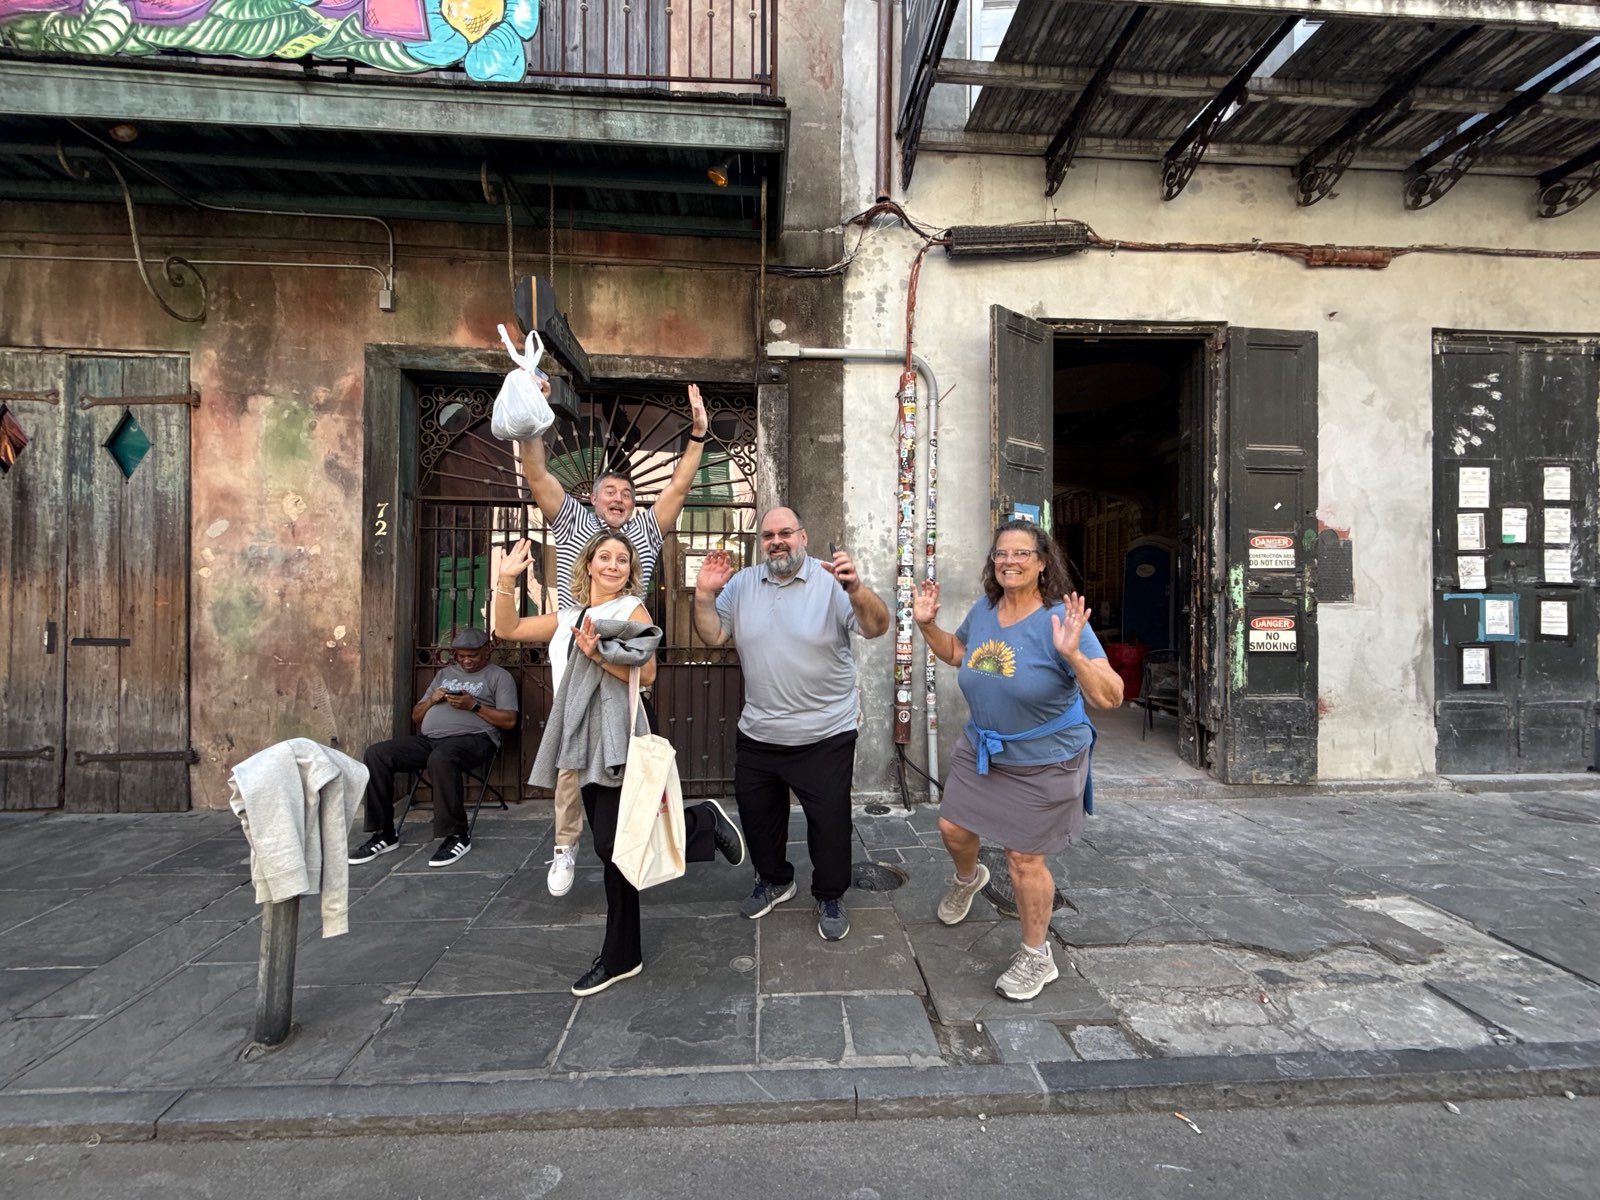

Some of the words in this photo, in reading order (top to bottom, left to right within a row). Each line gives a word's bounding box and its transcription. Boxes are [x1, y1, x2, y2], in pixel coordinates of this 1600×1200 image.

[1255, 538, 1289, 546] DANGER
[1255, 620, 1290, 628] DANGER
[1265, 632, 1280, 640] NO
[1249, 641, 1297, 650] SMOKING
